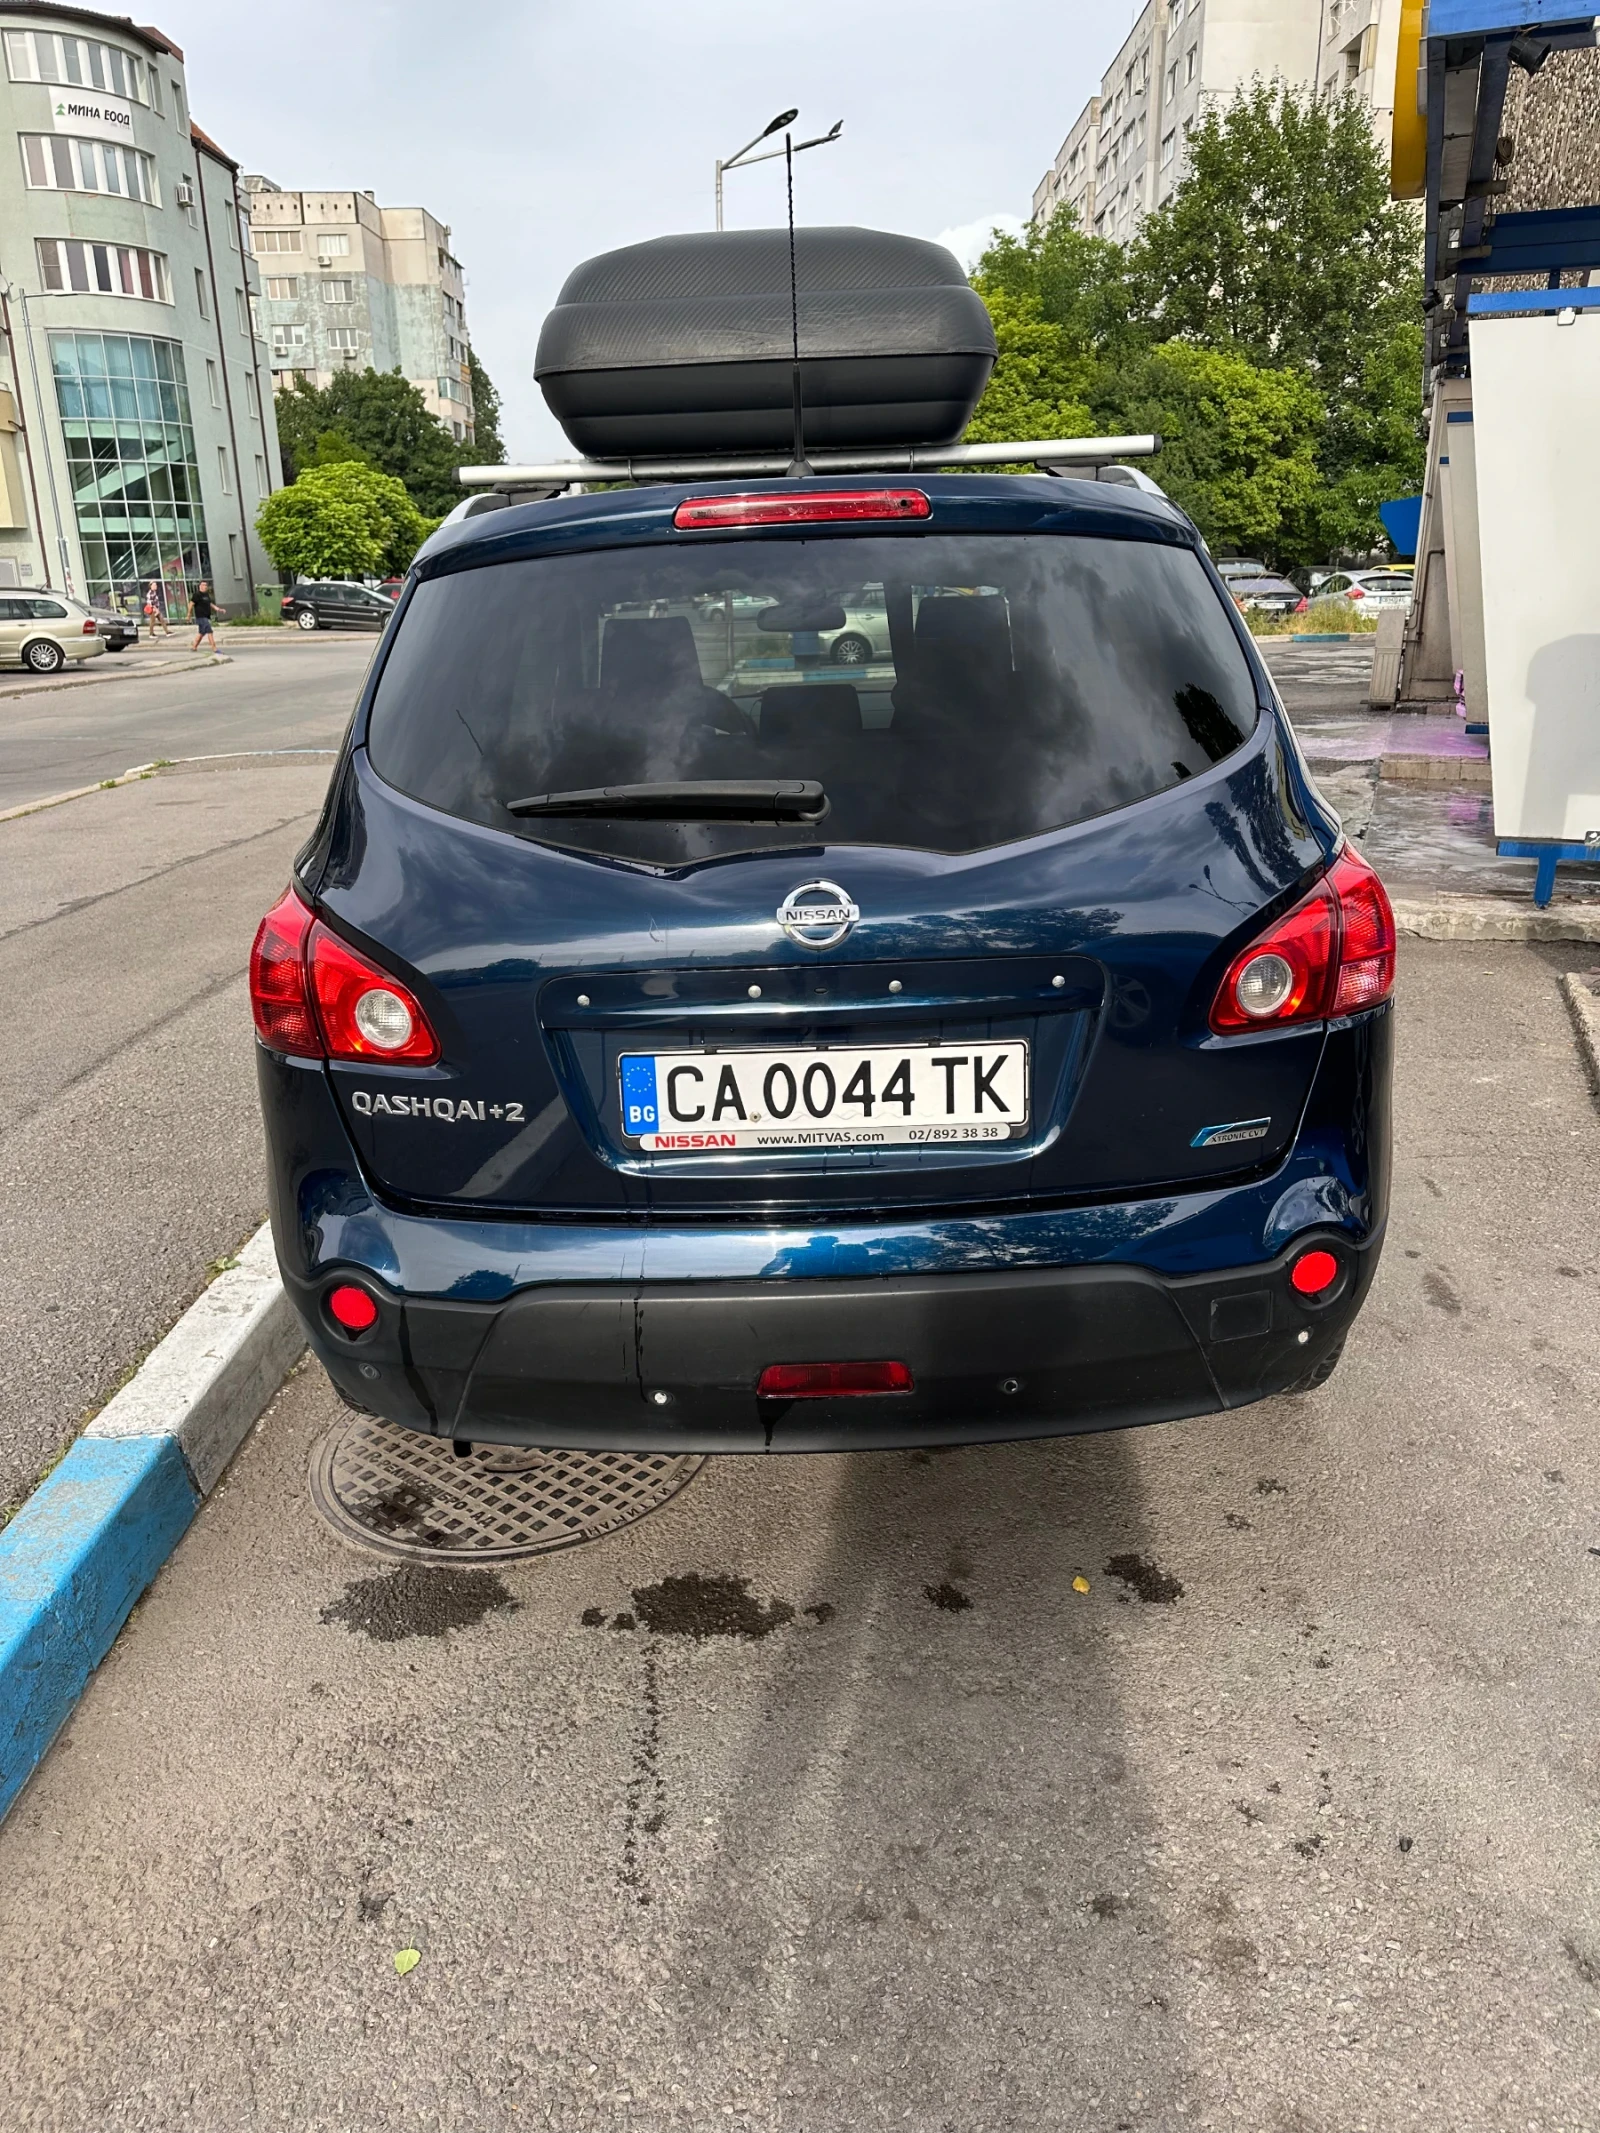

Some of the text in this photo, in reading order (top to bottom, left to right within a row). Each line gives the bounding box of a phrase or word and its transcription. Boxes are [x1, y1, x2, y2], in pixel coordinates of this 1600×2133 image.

[68, 103, 130, 126] МИНА ЕООД
[786, 908, 850, 921] NISSAN
[667, 1054, 1010, 1123] CA 0044 TK
[629, 1105, 656, 1123] BG
[655, 1126, 998, 1148] NISSAN www.MITVAS.com 02/892 38 38
[1211, 1128, 1265, 1143] XTRONIC CVT
